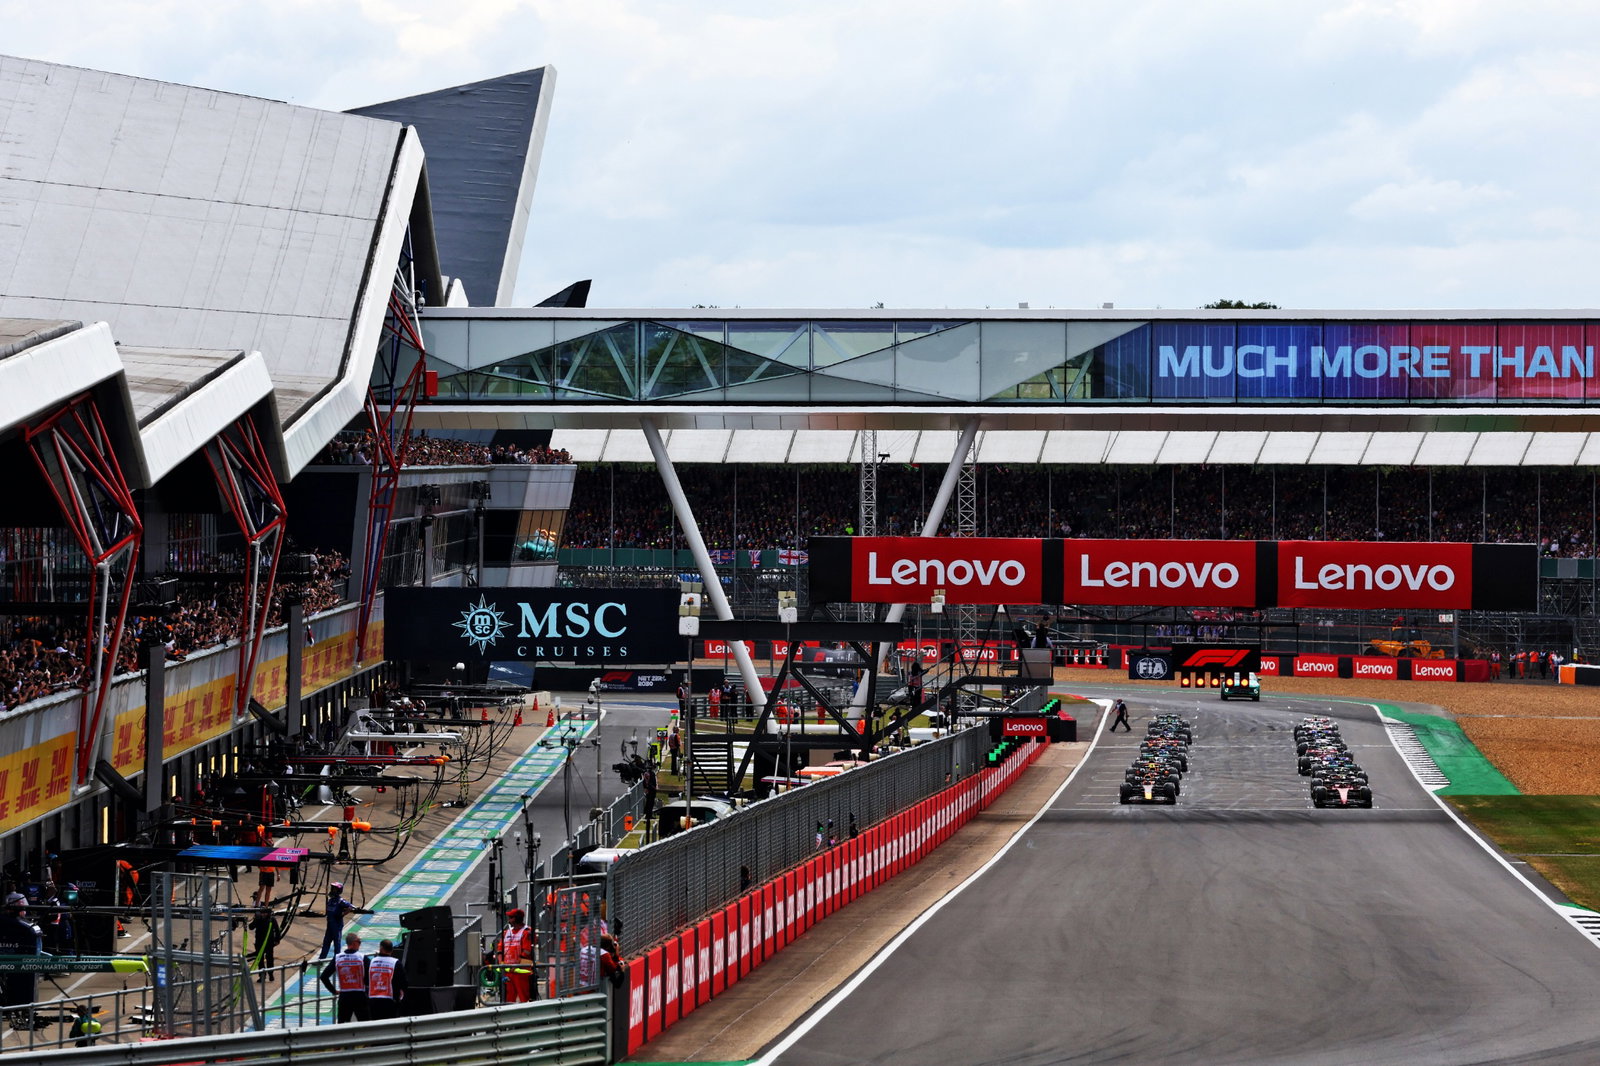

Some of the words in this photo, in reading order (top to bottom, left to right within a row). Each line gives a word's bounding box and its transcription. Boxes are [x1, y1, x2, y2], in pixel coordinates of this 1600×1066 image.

[1159, 345, 1297, 378] MUCH
[1310, 345, 1451, 378] MORE
[1460, 345, 1594, 378] THAN
[869, 552, 1025, 586] Lenovo
[1080, 554, 1240, 589] Lenovo
[1294, 556, 1455, 591] Lenovo
[517, 602, 627, 638] MSC
[517, 646, 627, 657] CRUISES
[1297, 660, 1335, 673] Lenovo
[1356, 662, 1393, 675] Lenovo
[1415, 664, 1453, 677] Lenovo
[1006, 722, 1043, 732] Lenovo
